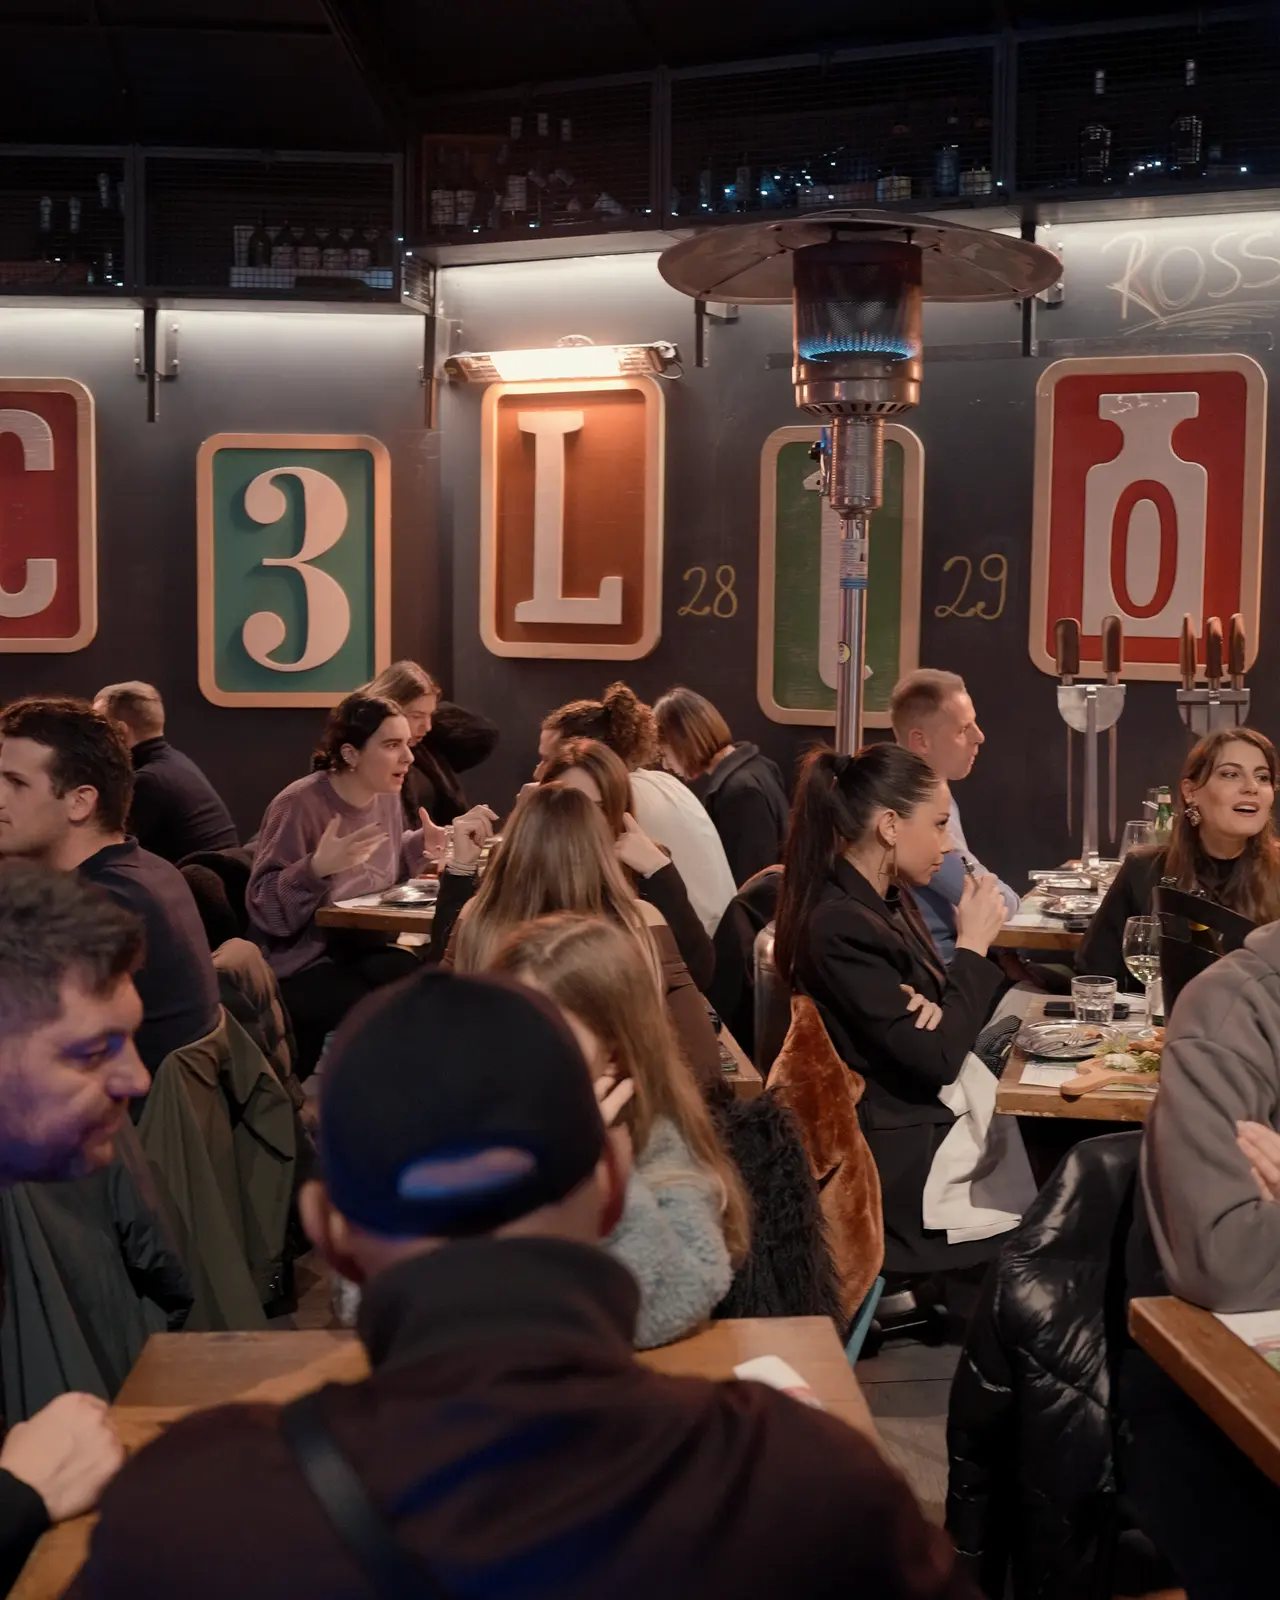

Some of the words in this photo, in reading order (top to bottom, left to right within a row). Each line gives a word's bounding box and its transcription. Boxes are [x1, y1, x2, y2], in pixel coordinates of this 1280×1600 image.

[242, 466, 351, 672] 3
[514, 410, 623, 625] L
[677, 565, 738, 618] 28
[934, 553, 1008, 620] 29
